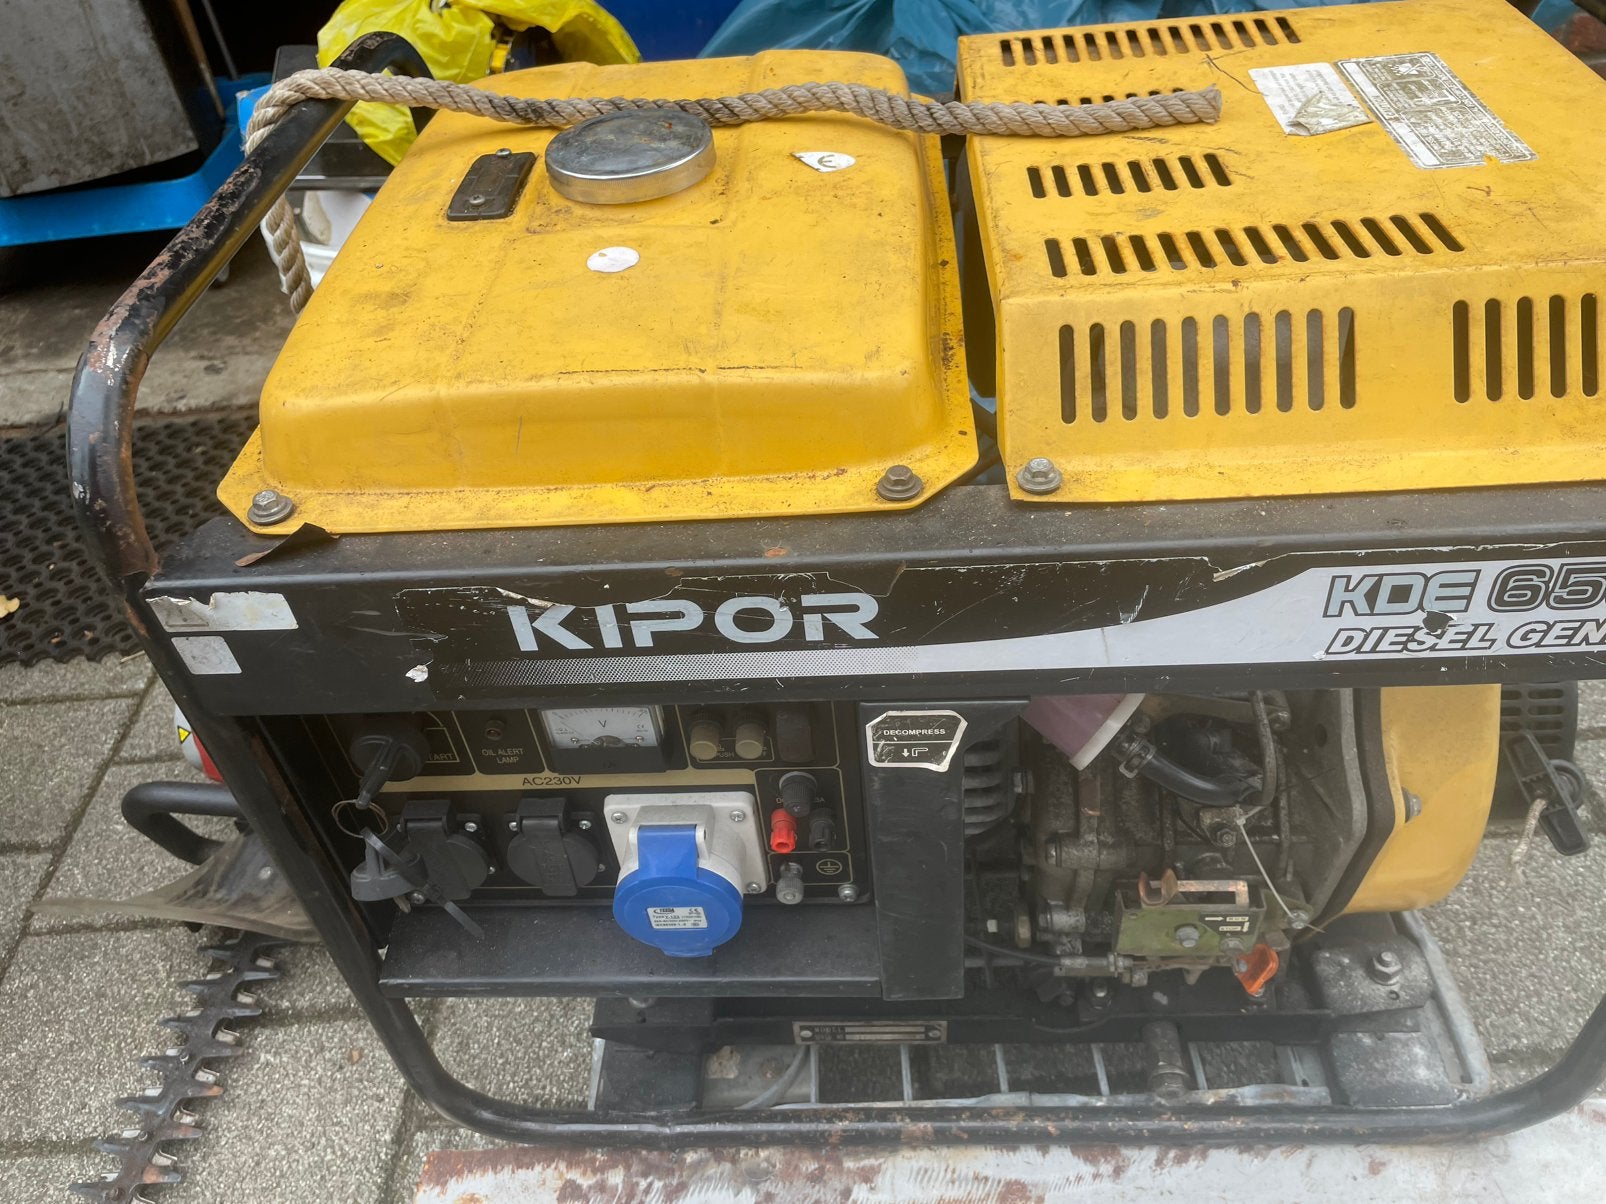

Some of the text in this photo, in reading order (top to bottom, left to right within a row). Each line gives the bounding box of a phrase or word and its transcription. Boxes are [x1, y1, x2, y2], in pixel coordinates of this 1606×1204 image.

[1323, 562, 1606, 618] KDE 65
[507, 592, 879, 651] KIPOR
[1324, 619, 1606, 655] DIESEL GEN
[883, 728, 946, 736] DECOMPRESS
[498, 748, 524, 756] ALERT
[496, 756, 519, 764] LAMP
[522, 776, 582, 786] AC230V
